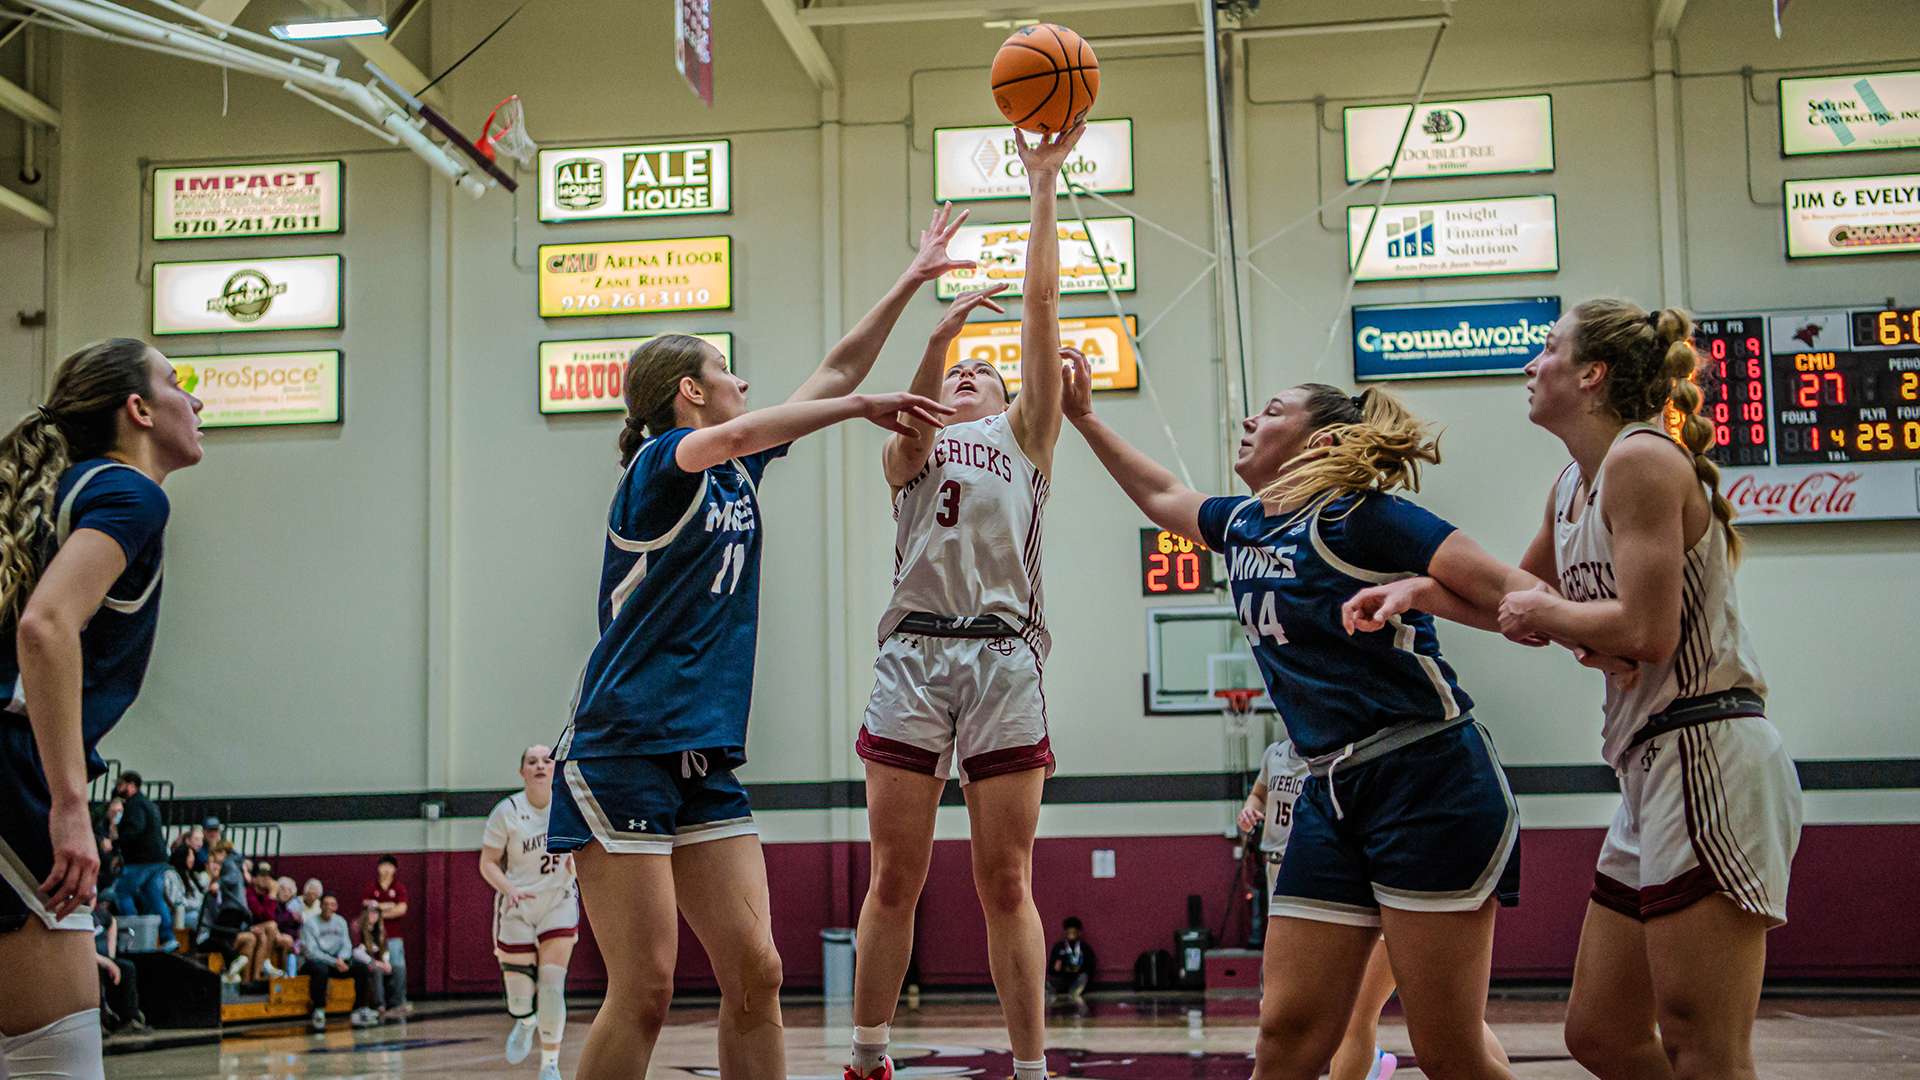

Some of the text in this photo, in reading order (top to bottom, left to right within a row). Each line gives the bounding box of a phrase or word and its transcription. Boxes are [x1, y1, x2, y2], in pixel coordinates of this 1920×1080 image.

[1808, 100, 1857, 112] SKYLINE
[559, 164, 602, 184] ALE
[626, 151, 709, 188] ALE
[1439, 162, 1468, 170] Hilton
[175, 171, 320, 191] IMPACT
[559, 183, 602, 197] HOUSE
[627, 187, 709, 210] HOUSE
[1792, 192, 1825, 209] JIM
[1833, 190, 1848, 207] &
[174, 215, 320, 233] 970.241.7611
[1446, 207, 1498, 222] Insight
[1446, 223, 1519, 240] Financial
[1446, 242, 1519, 256] Solutions
[546, 253, 598, 273] CMU
[561, 289, 710, 311] 970-261-3110
[1358, 318, 1548, 353] Groundworks
[1712, 337, 1760, 359] 0 9
[1720, 358, 1761, 379] 1 6
[1795, 352, 1836, 371] CMU
[203, 365, 318, 390] ProSpace
[550, 362, 629, 399] LIQUO
[1721, 380, 1762, 401] 1 0
[1799, 372, 1919, 408] 27 2
[1715, 401, 1764, 423] 0 10
[1781, 409, 1818, 424] FOULS
[1859, 407, 1888, 420] PLYR
[1717, 423, 1765, 446] 0 0
[1811, 427, 1820, 451] 1
[1830, 428, 1845, 447] 4
[1857, 423, 1894, 451] 25
[936, 479, 962, 528] 3
[711, 542, 745, 595] 11
[1147, 552, 1200, 592] 20
[1230, 544, 1298, 581] MINES
[1239, 591, 1290, 647] 44
[1275, 800, 1291, 827] 15
[540, 854, 561, 875] 25
